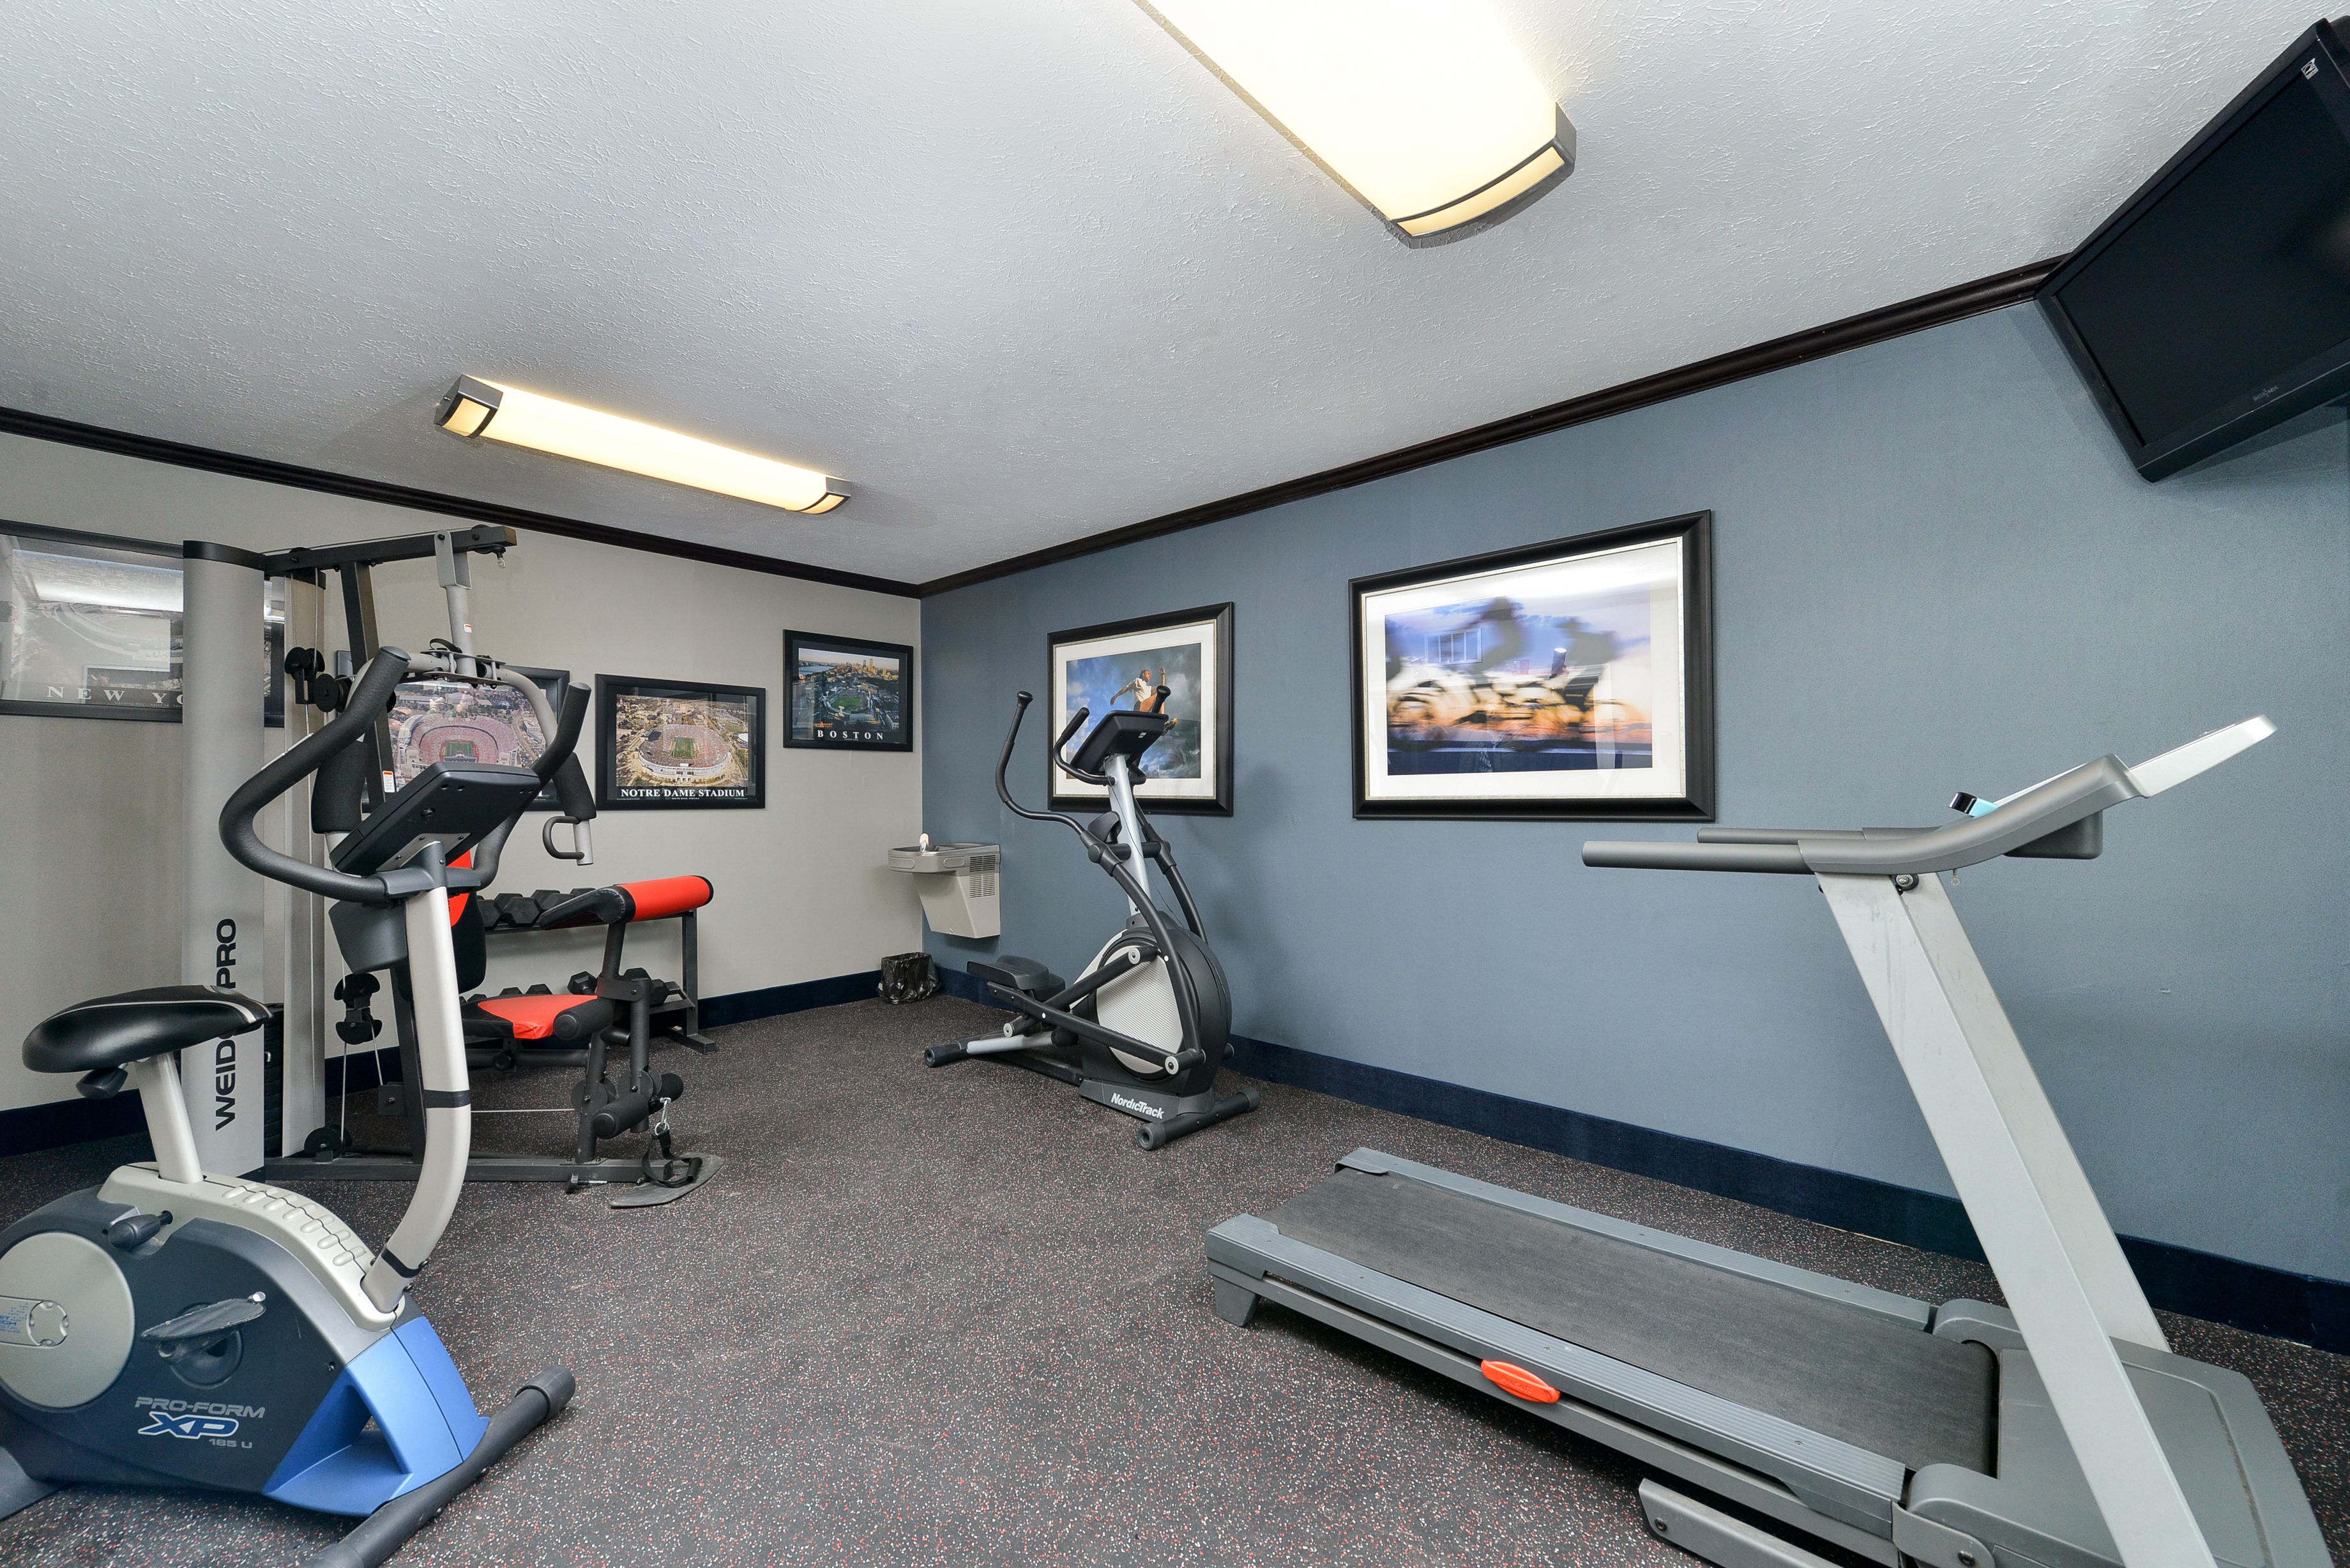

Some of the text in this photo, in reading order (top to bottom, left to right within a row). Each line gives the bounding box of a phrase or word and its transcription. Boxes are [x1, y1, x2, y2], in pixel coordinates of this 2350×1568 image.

[47, 685, 126, 702] NEW
[817, 730, 883, 740] BOSTON
[621, 788, 745, 797] NOTRE DAME STADIUM
[216, 917, 236, 990] PRO
[215, 1036, 236, 1131] WEID
[1111, 1092, 1164, 1120] NordicTrack
[134, 1396, 266, 1419] PRO-FORM
[137, 1411, 239, 1440] XP
[241, 1441, 253, 1449] U
